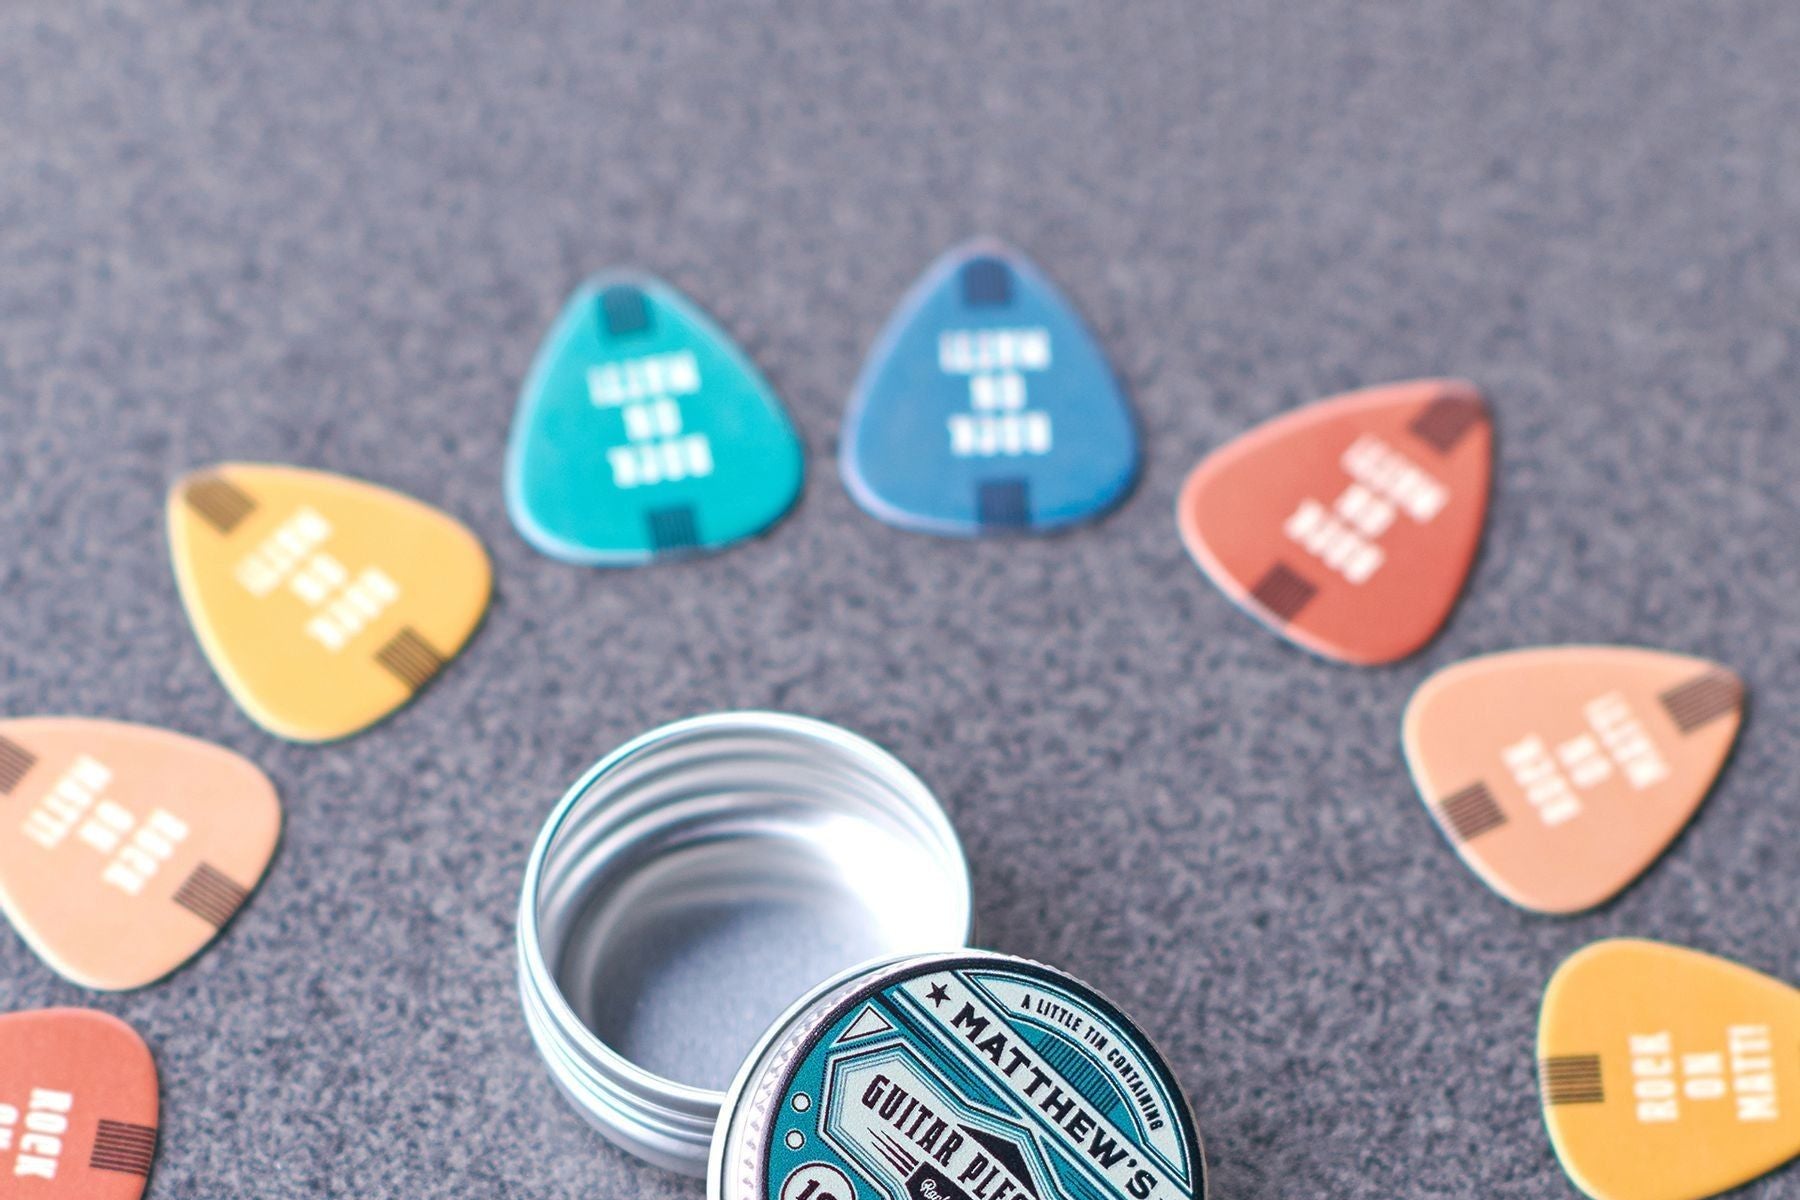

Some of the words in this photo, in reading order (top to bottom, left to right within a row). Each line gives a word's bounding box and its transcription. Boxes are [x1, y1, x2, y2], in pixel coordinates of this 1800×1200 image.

[950, 1001, 1158, 1199] MATTHEW'S
[1021, 994, 1030, 1009] A
[1036, 998, 1083, 1032] LITTLE
[1084, 1025, 1109, 1051] TIN
[1106, 1048, 1163, 1131] CONTAINING
[1630, 1032, 1679, 1123] ROCK
[1683, 1052, 1726, 1099] ON
[1728, 1025, 1778, 1121] MATT!
[13, 1087, 73, 1180] ROCK
[861, 1074, 964, 1167] GUITAR
